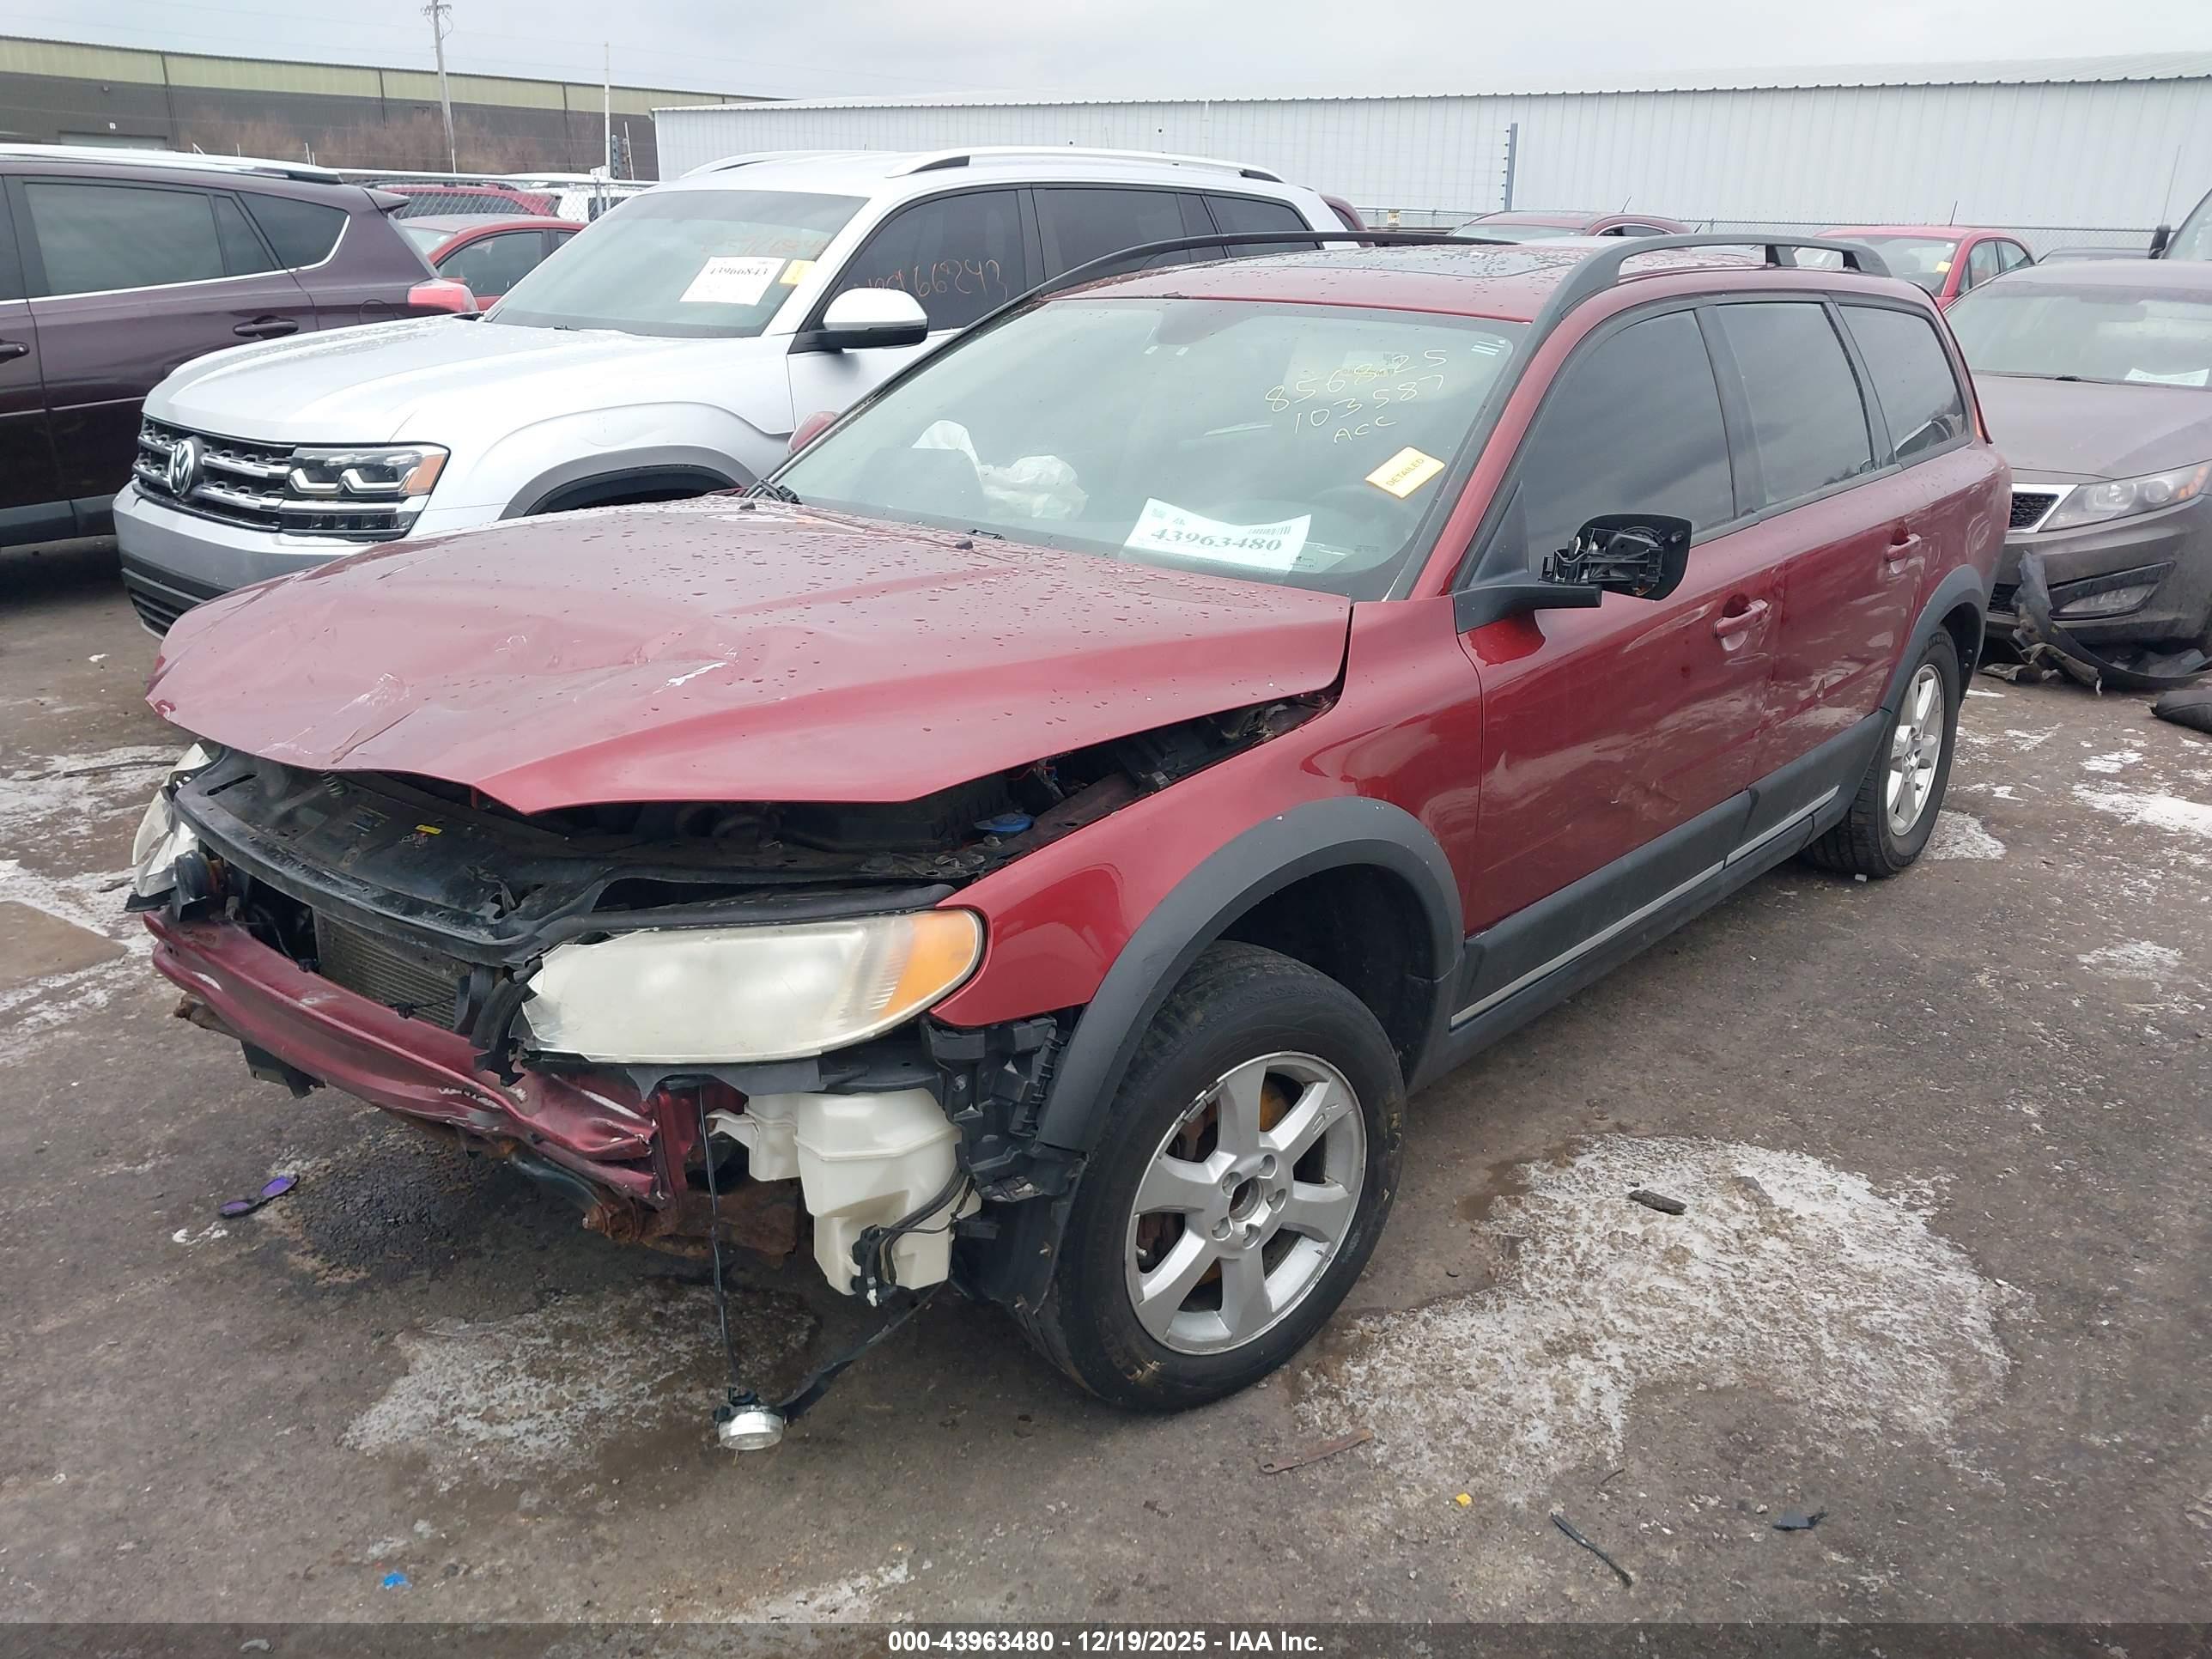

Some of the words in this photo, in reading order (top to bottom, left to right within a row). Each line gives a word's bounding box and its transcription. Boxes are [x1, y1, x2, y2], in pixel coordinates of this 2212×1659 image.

[1294, 374, 1444, 434] 103587
[1334, 415, 1397, 444] ACC
[1385, 458, 1425, 487] DETAILED
[1150, 528, 1283, 551] 43963480
